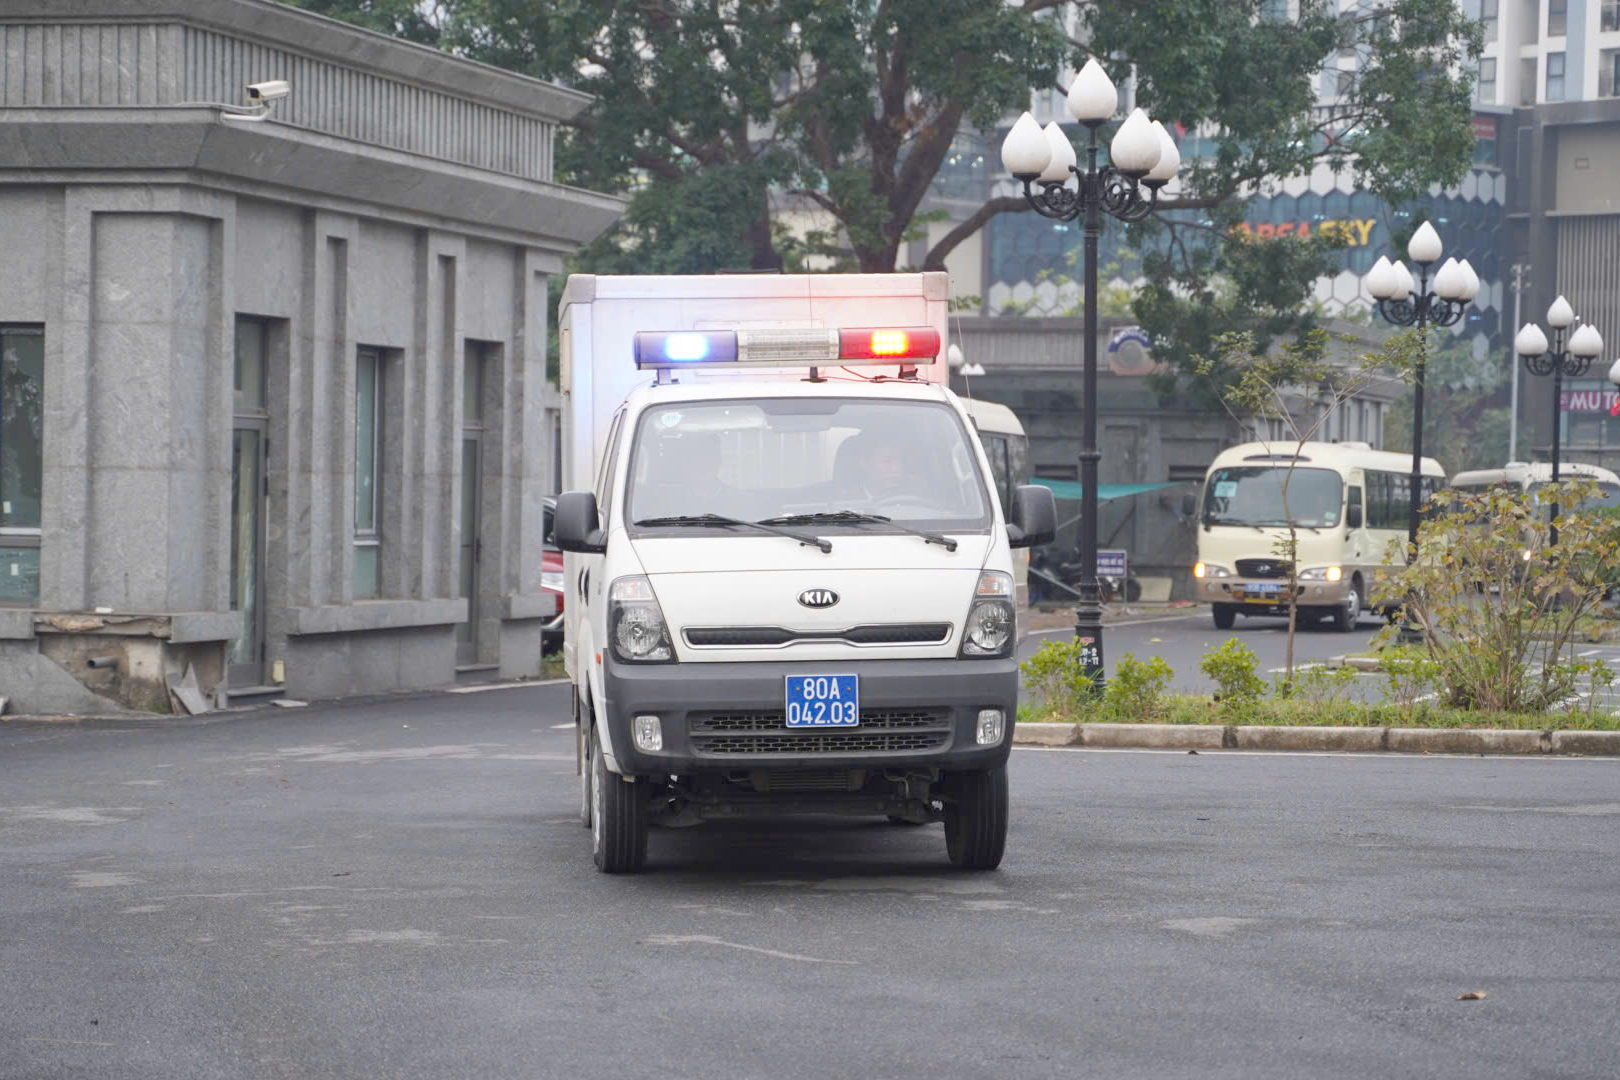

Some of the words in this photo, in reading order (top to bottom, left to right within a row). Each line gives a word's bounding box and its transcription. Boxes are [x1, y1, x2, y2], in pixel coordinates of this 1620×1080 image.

[804, 591, 834, 604] KIA
[803, 677, 841, 700] 80A
[788, 701, 856, 724] 042.03
